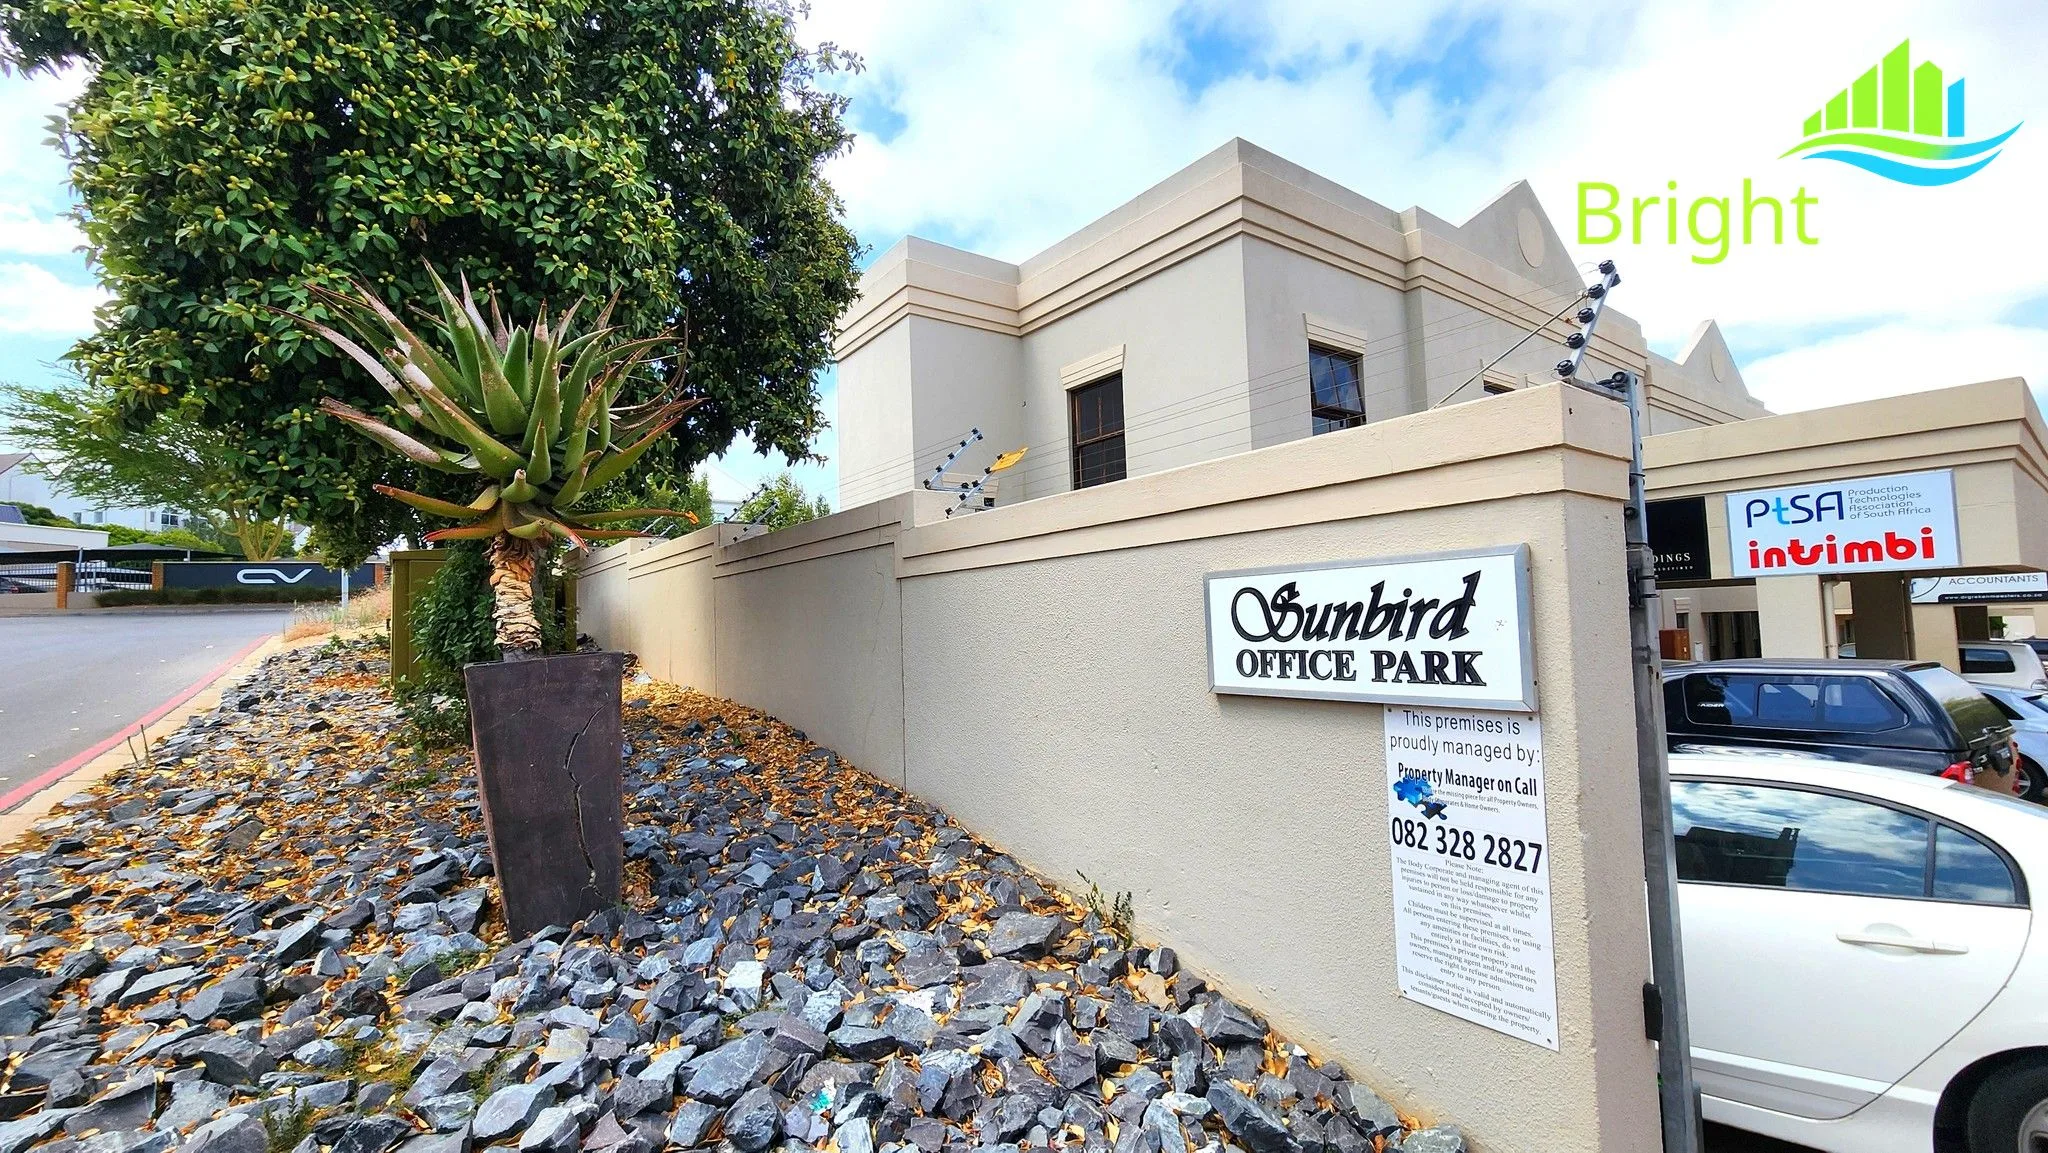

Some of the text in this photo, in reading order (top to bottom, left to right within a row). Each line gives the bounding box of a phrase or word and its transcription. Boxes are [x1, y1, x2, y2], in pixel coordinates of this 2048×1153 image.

[1848, 485, 1909, 496] Production
[1848, 492, 1922, 504] Technologies
[1849, 501, 1913, 512] Association
[1863, 509, 1895, 518] South
[1898, 507, 1931, 515] Africa
[1948, 574, 2039, 585] ACCOUNTANTS
[1231, 570, 1481, 643] Sunbird
[1236, 649, 1487, 686] OFFICE PARK
[1403, 710, 1521, 735] This premises is
[1390, 734, 1540, 767] proudly managed by:
[1398, 762, 1537, 797] Property Manager on Call
[1392, 816, 1543, 874] 082 328 2827
[1450, 876, 1458, 884] be
[1444, 894, 1454, 902] any
[1403, 906, 1412, 914] All
[1502, 942, 1511, 950] do
[1434, 957, 1443, 965] the
[1493, 1004, 1502, 1013] by
